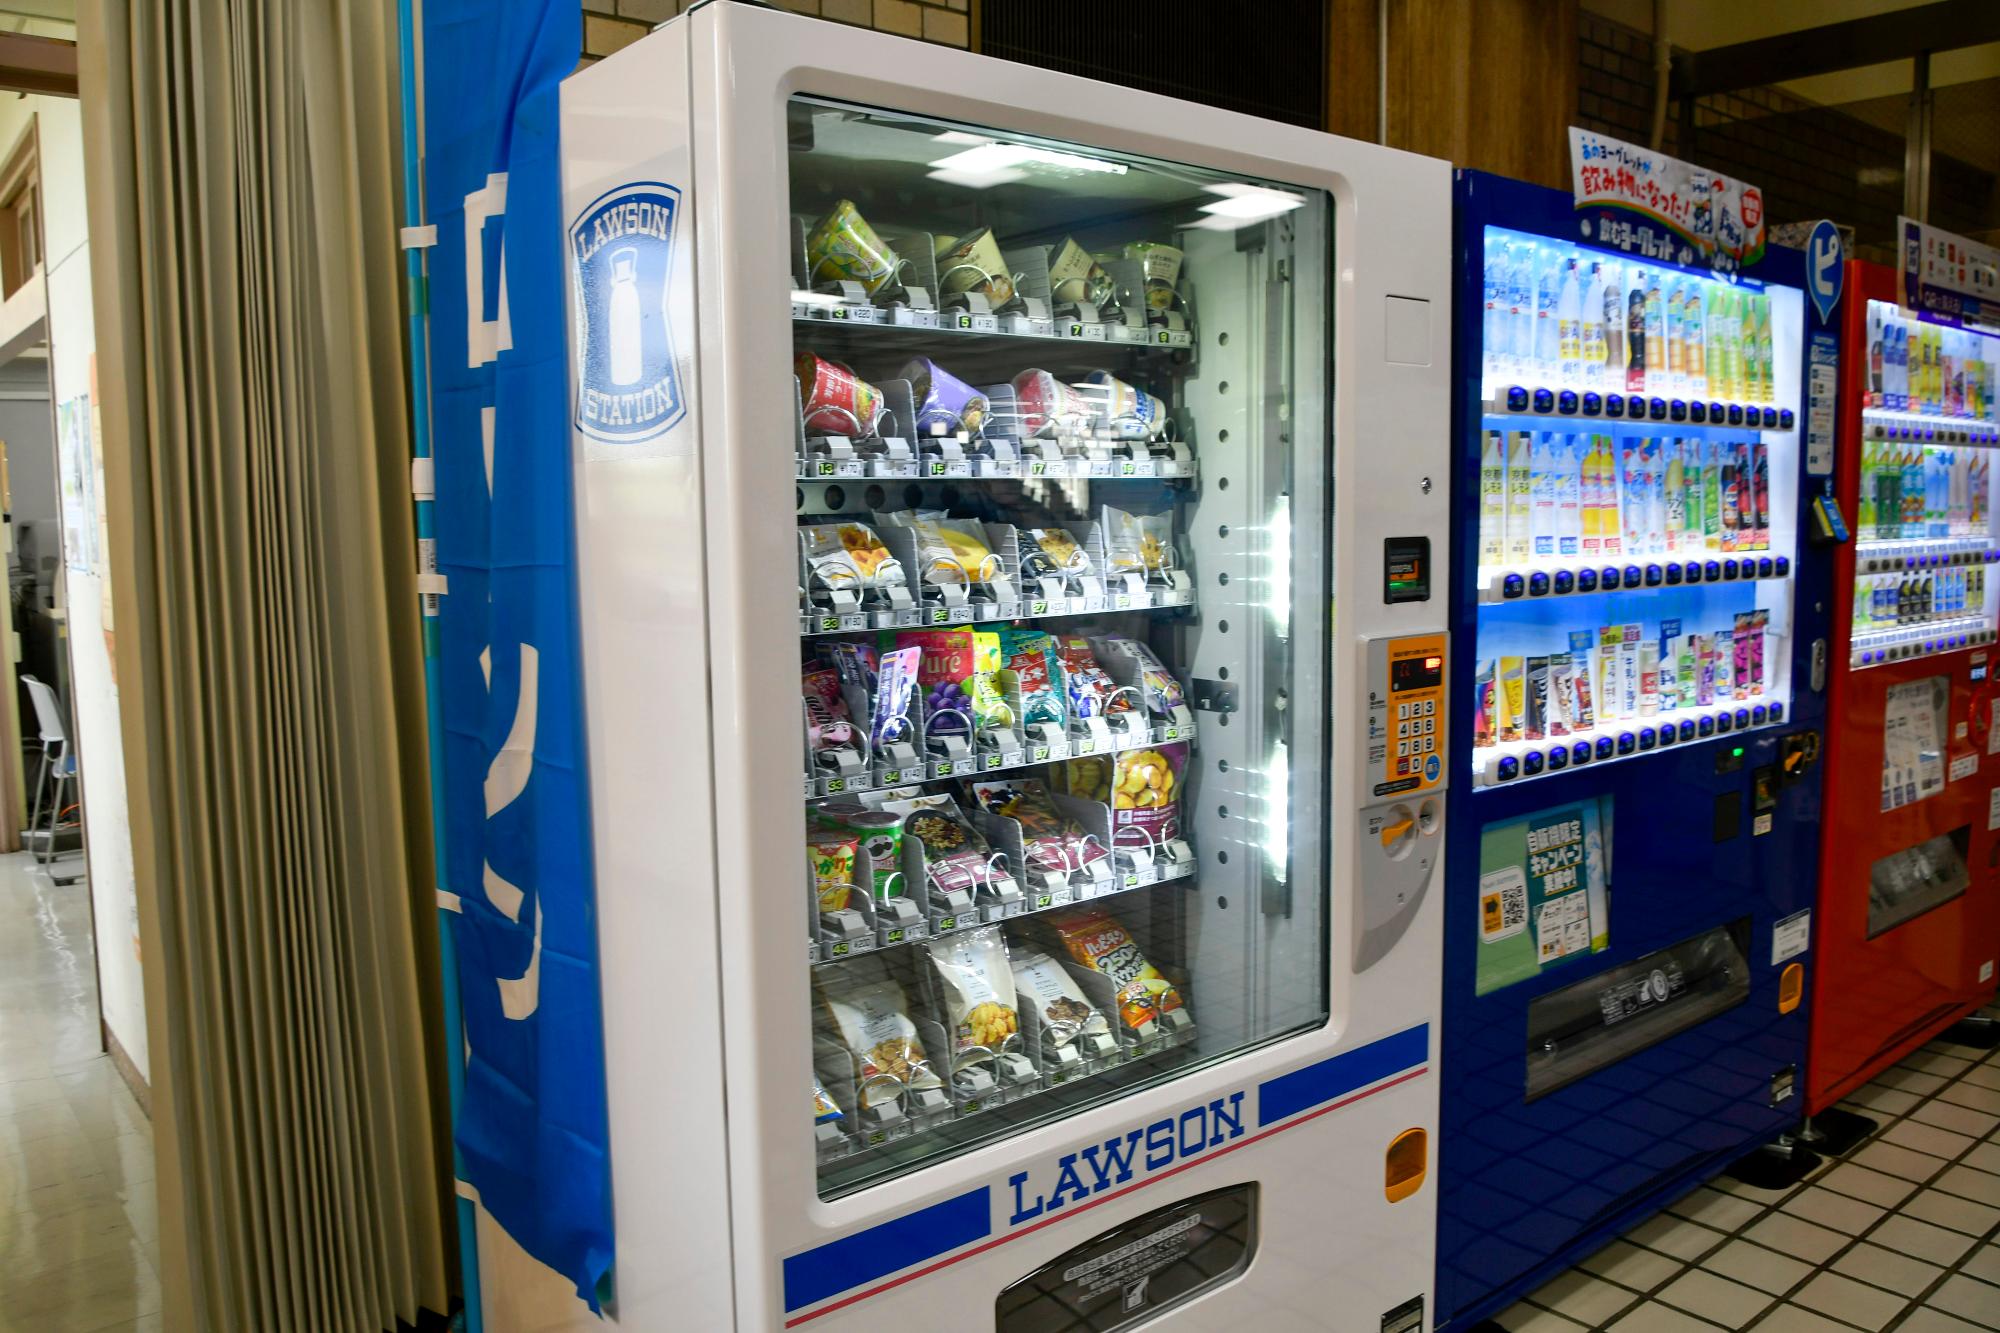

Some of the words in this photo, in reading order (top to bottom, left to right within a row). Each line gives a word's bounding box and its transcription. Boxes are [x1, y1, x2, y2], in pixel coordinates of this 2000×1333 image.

[578, 202, 670, 262] LAWSON
[960, 316, 970, 327] 5
[1072, 326, 1081, 336] 7
[585, 376, 674, 425] STATION
[819, 464, 833, 475] 13
[931, 464, 944, 475] 15
[1031, 464, 1045, 475] 17
[1413, 703, 1420, 715] 2
[1426, 701, 1433, 713] 3
[1400, 724, 1407, 734] 4
[1413, 721, 1420, 733] 5
[1426, 719, 1433, 731] 6
[1400, 743, 1407, 755] 7
[1413, 740, 1420, 752] 8
[1426, 738, 1433, 750] 9
[1413, 758, 1420, 770] 0
[884, 772, 899, 783] 34
[828, 780, 844, 791] 33
[1531, 844, 1583, 876] キャンペーン
[832, 943, 849, 955] 43
[1008, 1090, 1245, 1226] LAWSON
